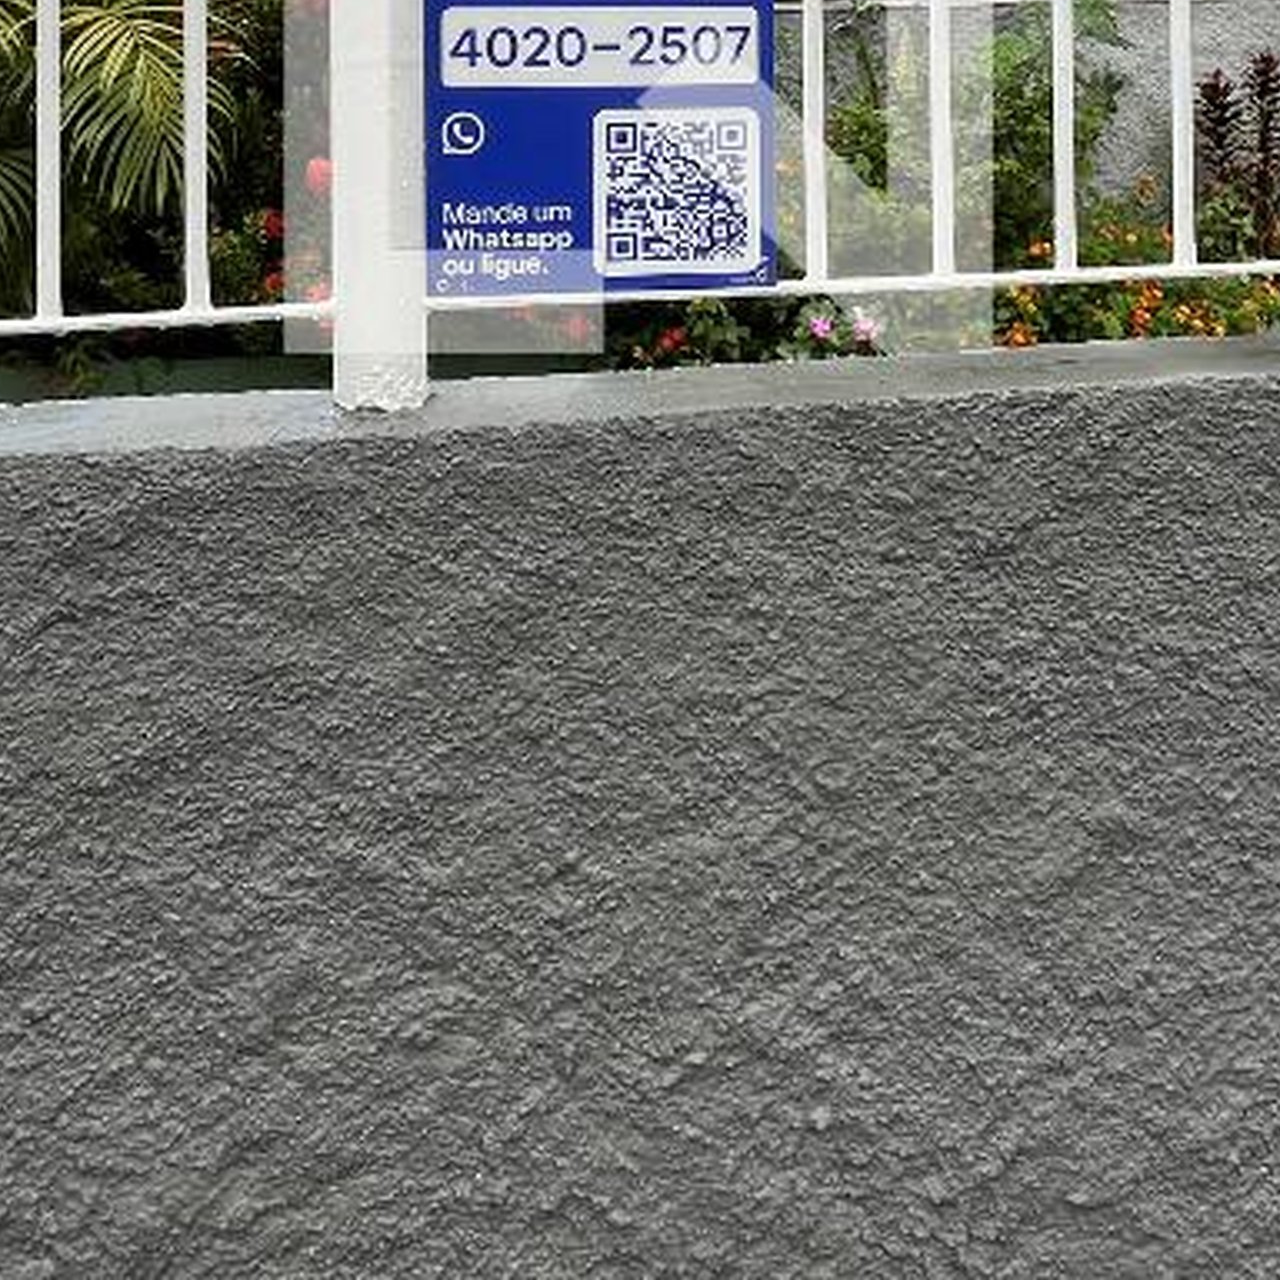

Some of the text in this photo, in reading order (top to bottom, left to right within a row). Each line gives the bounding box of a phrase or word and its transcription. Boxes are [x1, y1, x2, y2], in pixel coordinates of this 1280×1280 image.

[449, 25, 752, 68] 4020-2507
[442, 202, 573, 224] Mande um
[442, 227, 575, 254] Whatsapp
[442, 253, 549, 281] ou ligue.
